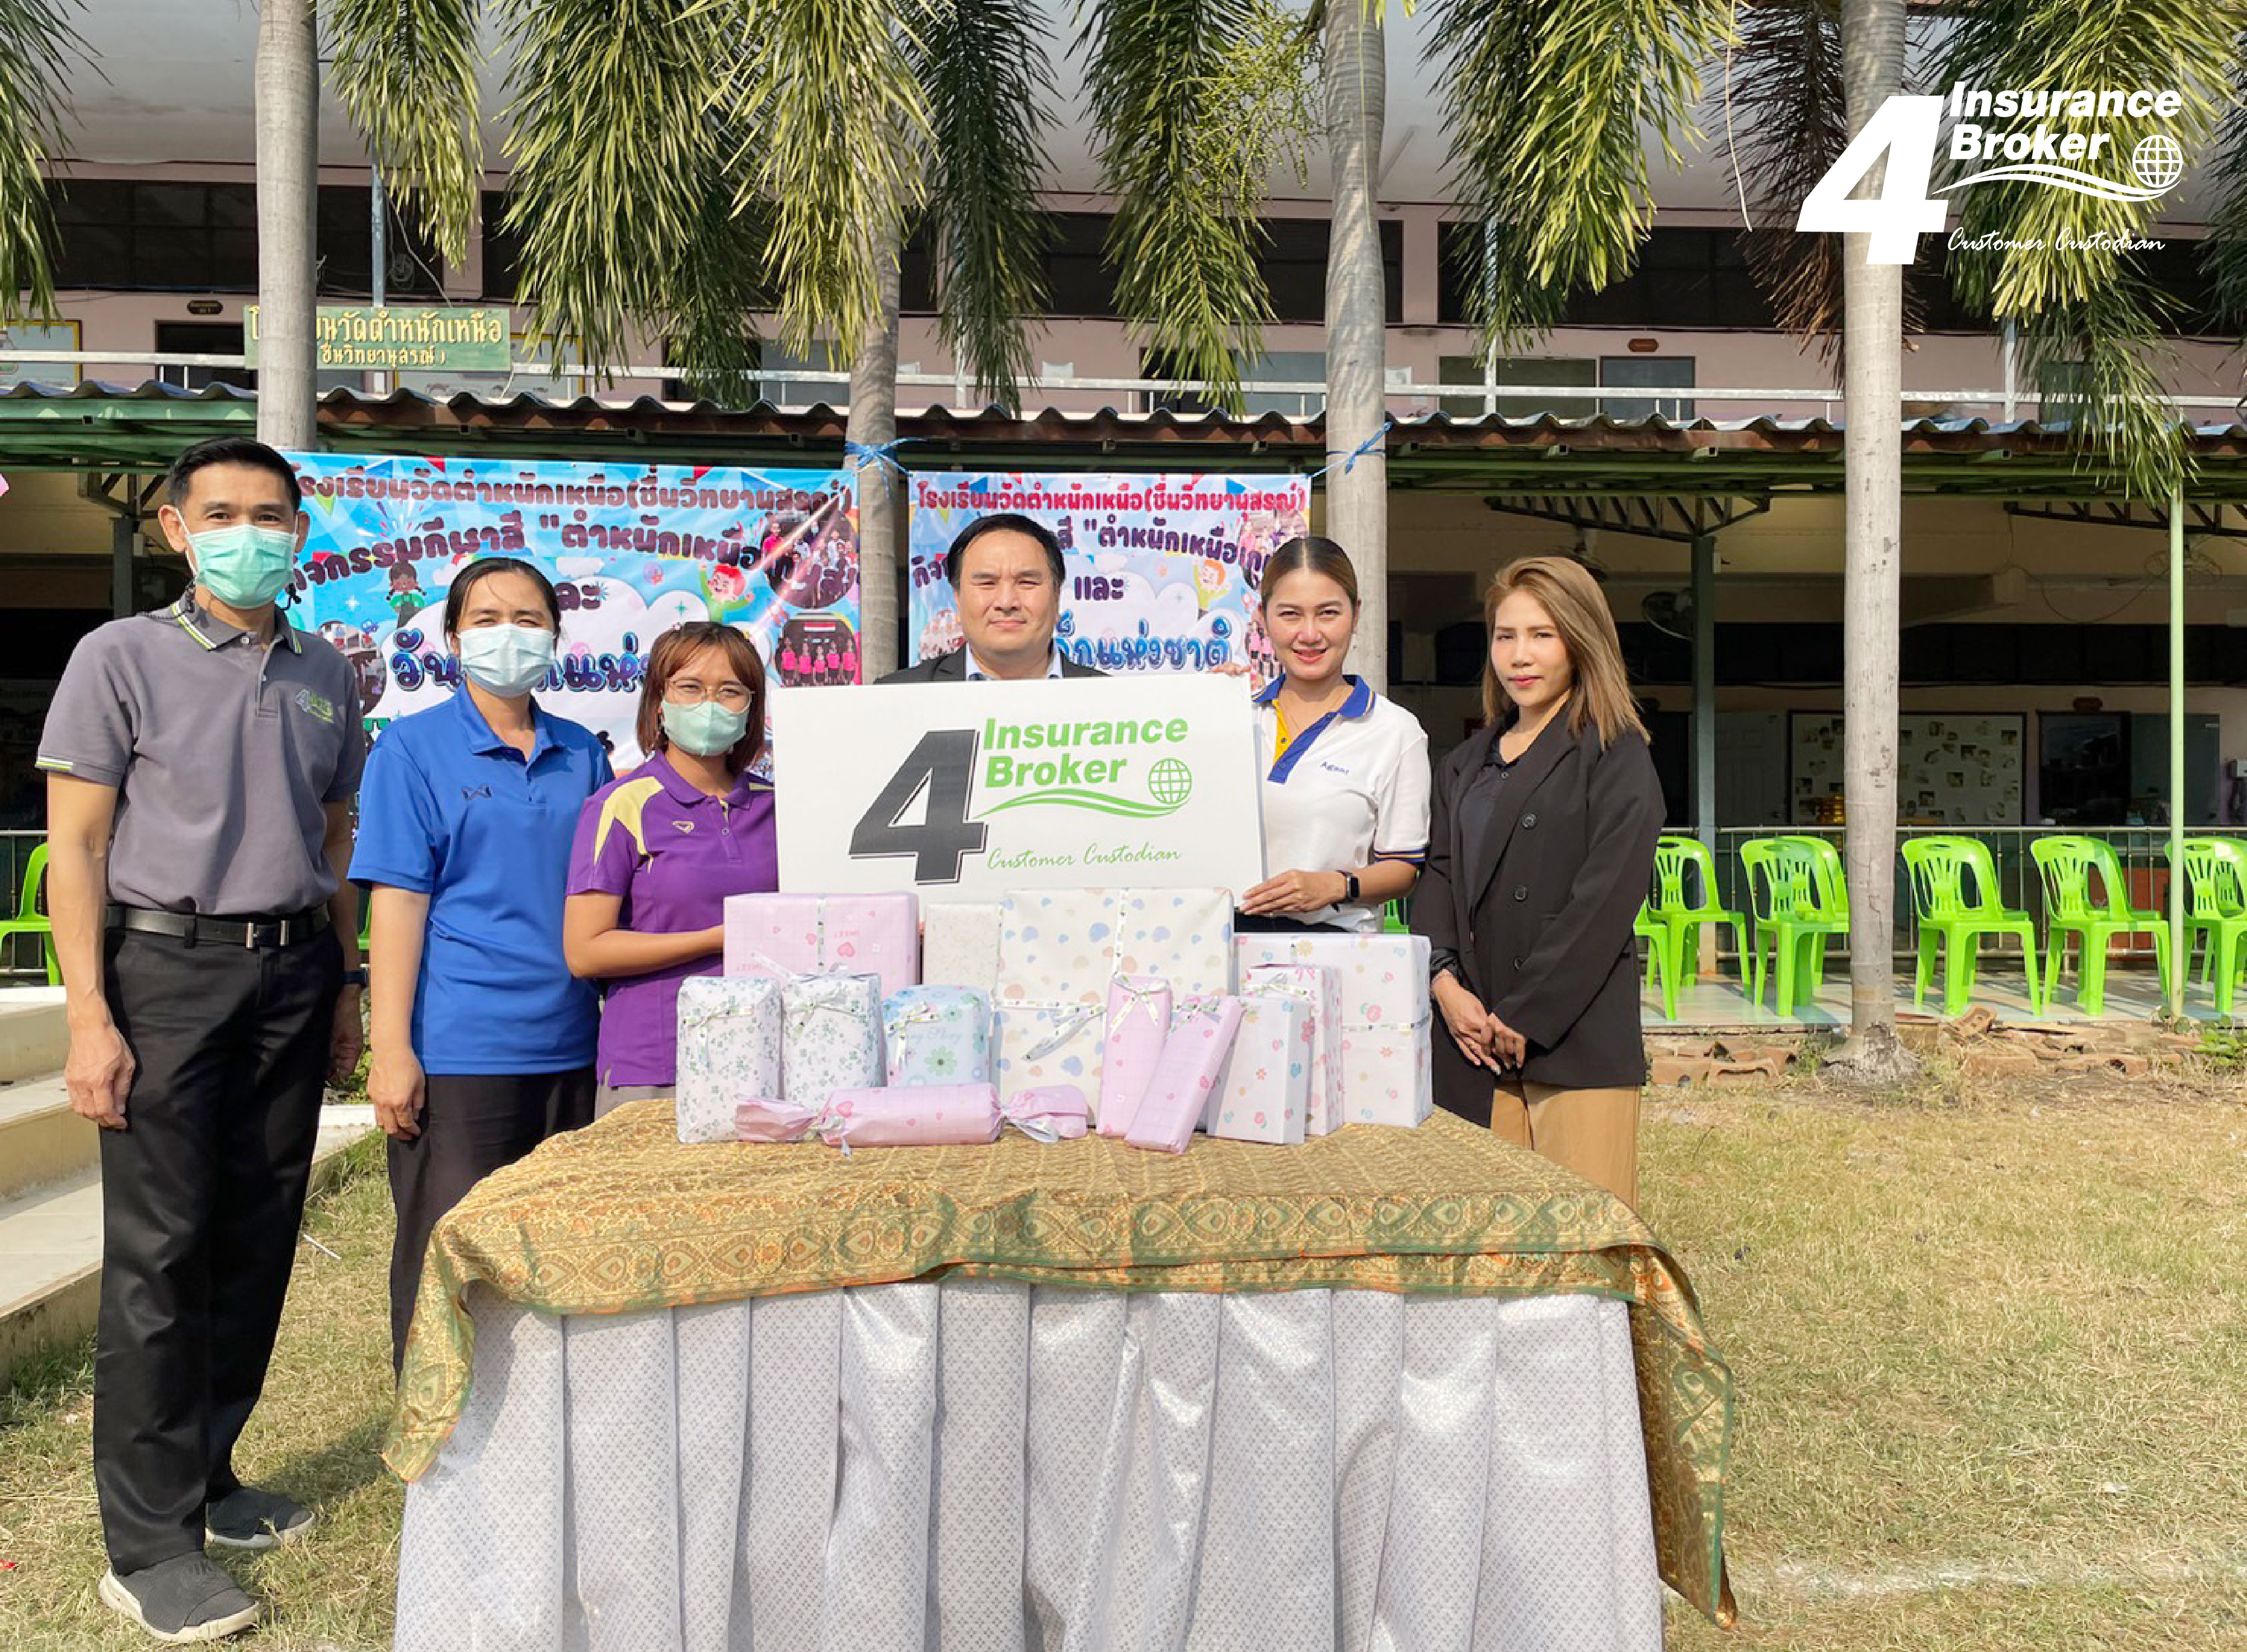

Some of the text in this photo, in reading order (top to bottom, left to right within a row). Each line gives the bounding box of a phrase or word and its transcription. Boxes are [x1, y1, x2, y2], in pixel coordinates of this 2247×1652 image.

[292, 463, 852, 517] รงเรียนวัดตำหนักเหนือ(ชื่นวิทยานุสรณ์)
[1073, 575, 1124, 601] และ
[983, 717, 1189, 750] Insurance
[985, 754, 1128, 789] Broker
[848, 728, 989, 885] 4
[987, 840, 1182, 870] Customer Custodian
